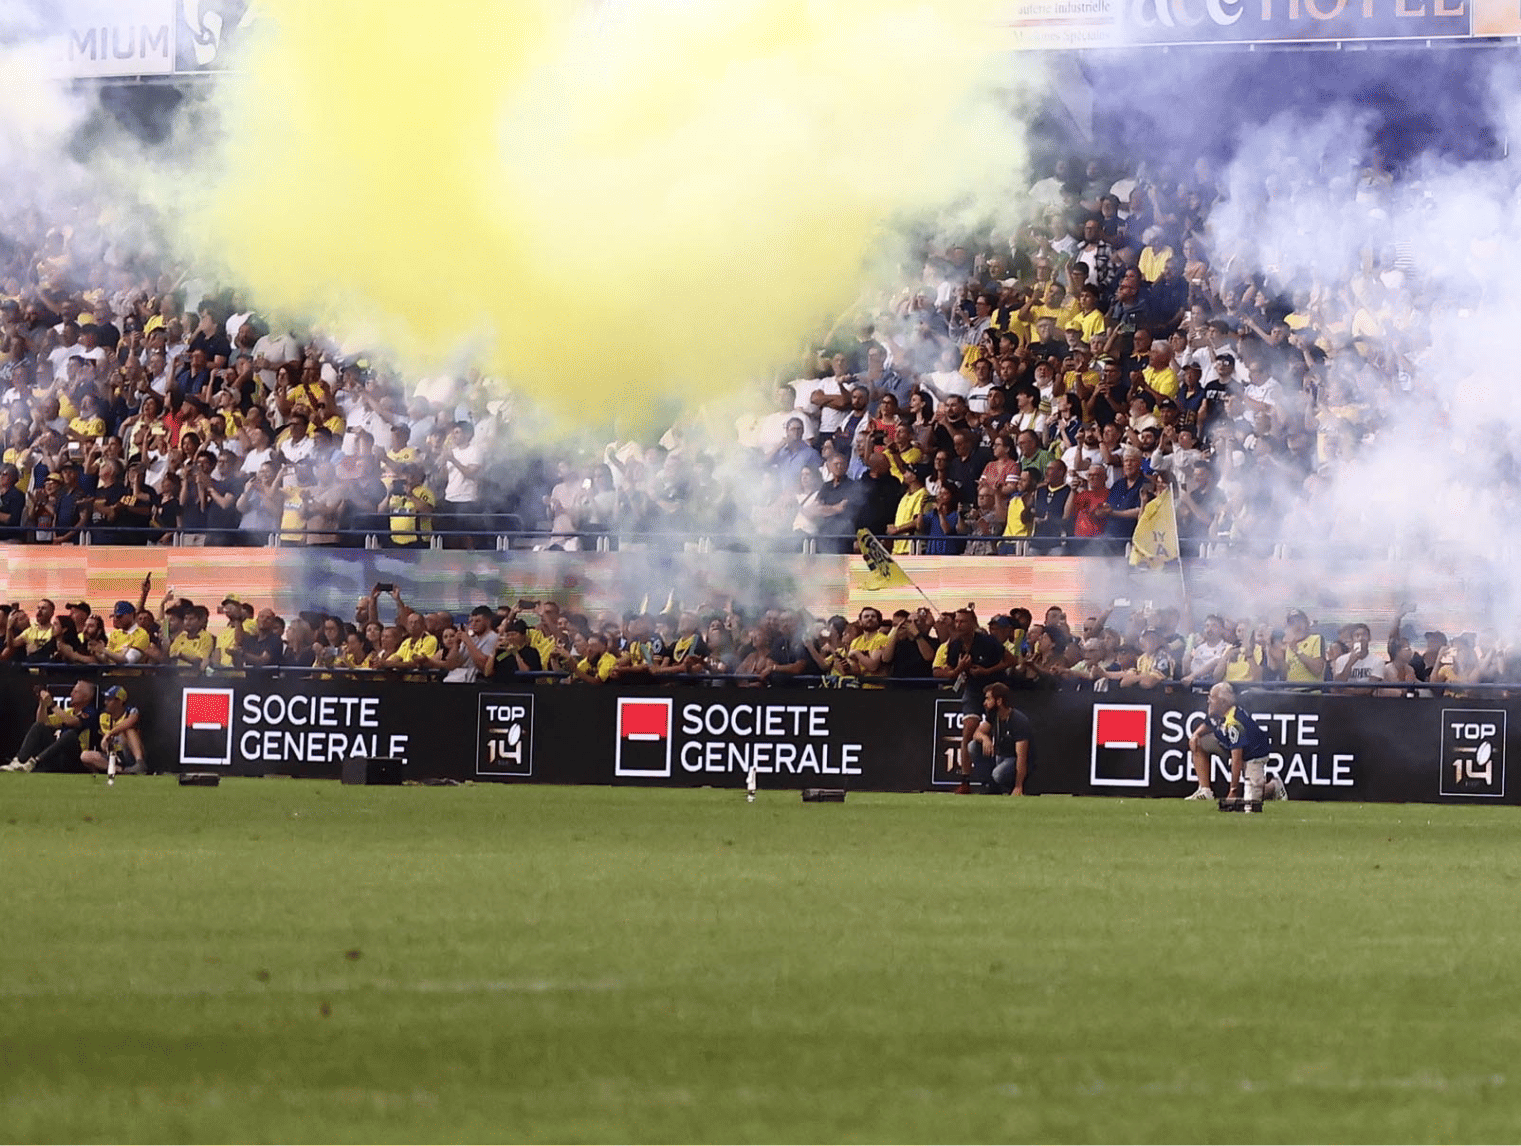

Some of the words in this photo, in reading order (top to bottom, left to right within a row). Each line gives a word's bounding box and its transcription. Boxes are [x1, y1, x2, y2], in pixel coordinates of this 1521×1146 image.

[68, 25, 169, 61] MIUM
[243, 694, 380, 727] SOCIETE
[486, 705, 525, 722] TOP
[682, 703, 830, 736] SOCIETE
[240, 730, 409, 765] GENERALE
[1451, 723, 1496, 740] TOP
[487, 739, 522, 765] 14
[680, 741, 862, 775] GENERALE
[1452, 759, 1493, 785] 14
